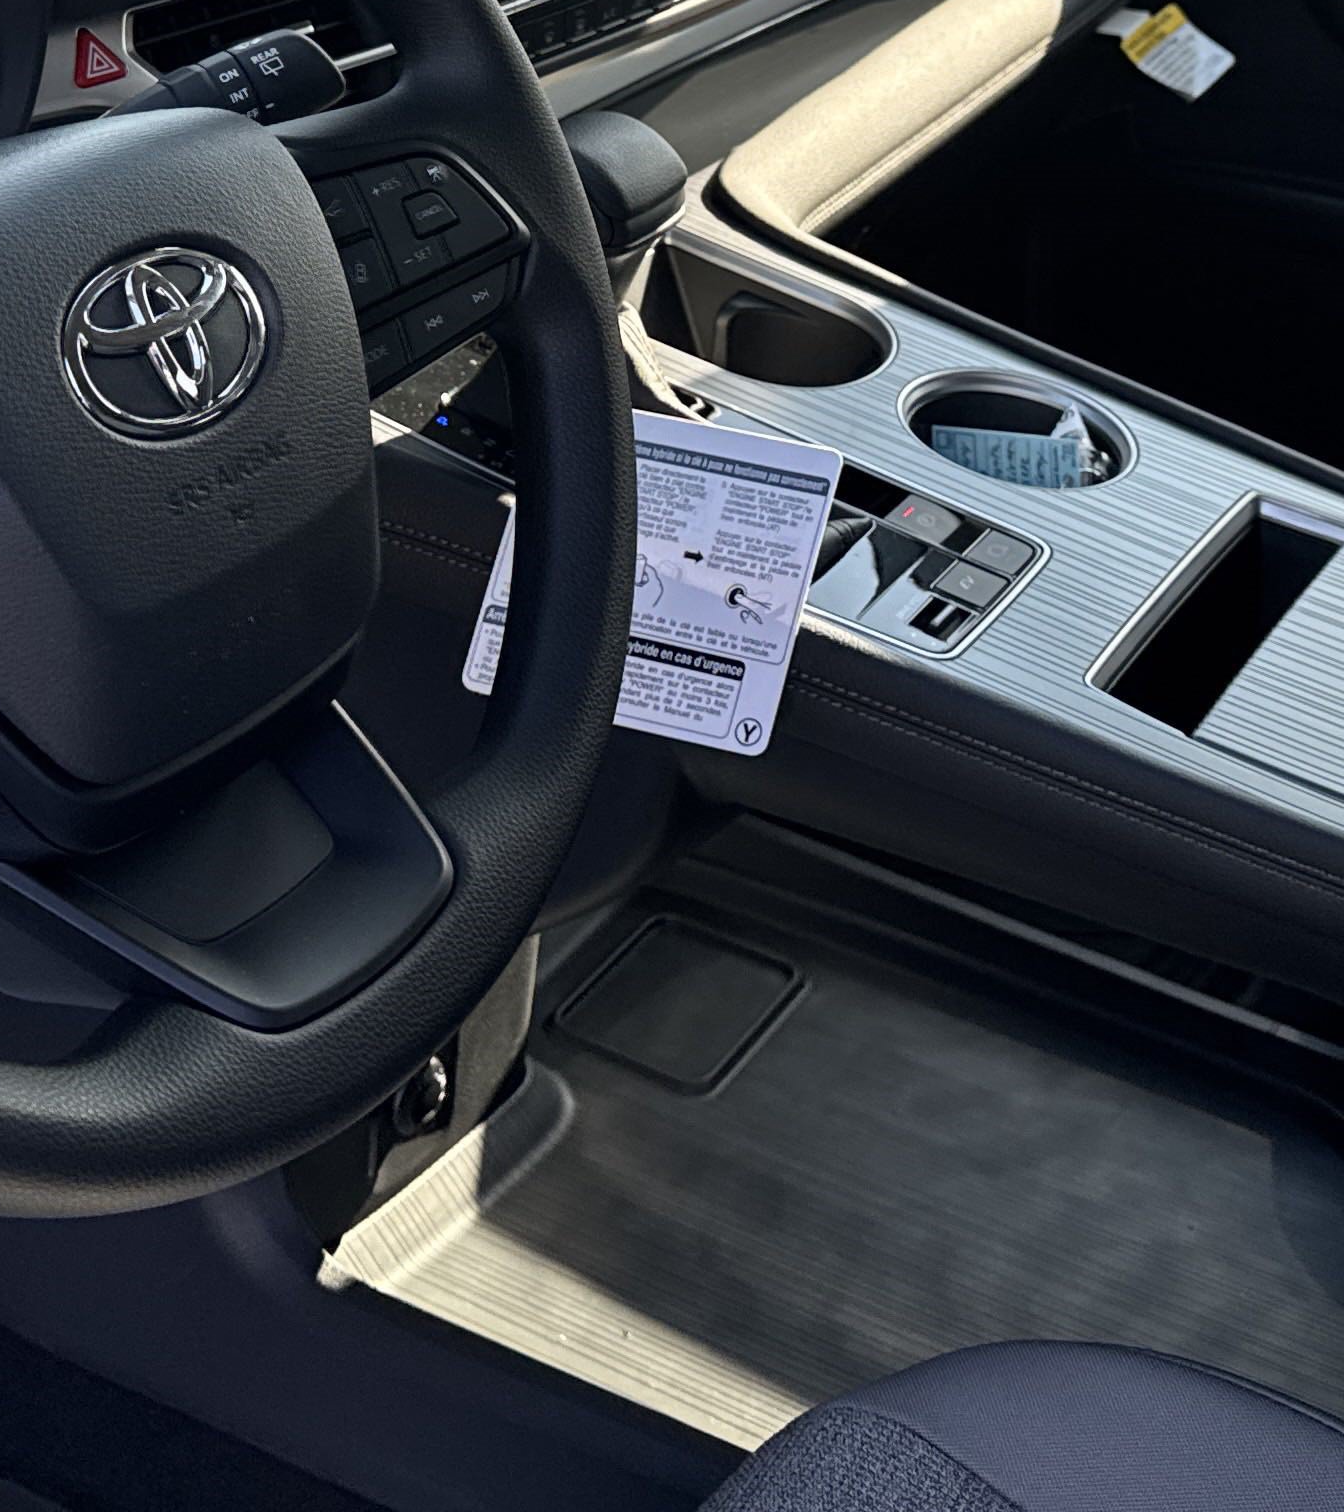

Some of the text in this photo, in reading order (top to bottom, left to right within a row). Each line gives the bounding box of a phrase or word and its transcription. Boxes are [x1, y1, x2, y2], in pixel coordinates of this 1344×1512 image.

[250, 47, 279, 65] REAR
[218, 69, 240, 84] ON
[229, 87, 249, 104] INT
[659, 649, 674, 661] en
[673, 651, 692, 665] cas
[692, 654, 745, 679] d'urgence
[743, 722, 758, 743] Y
